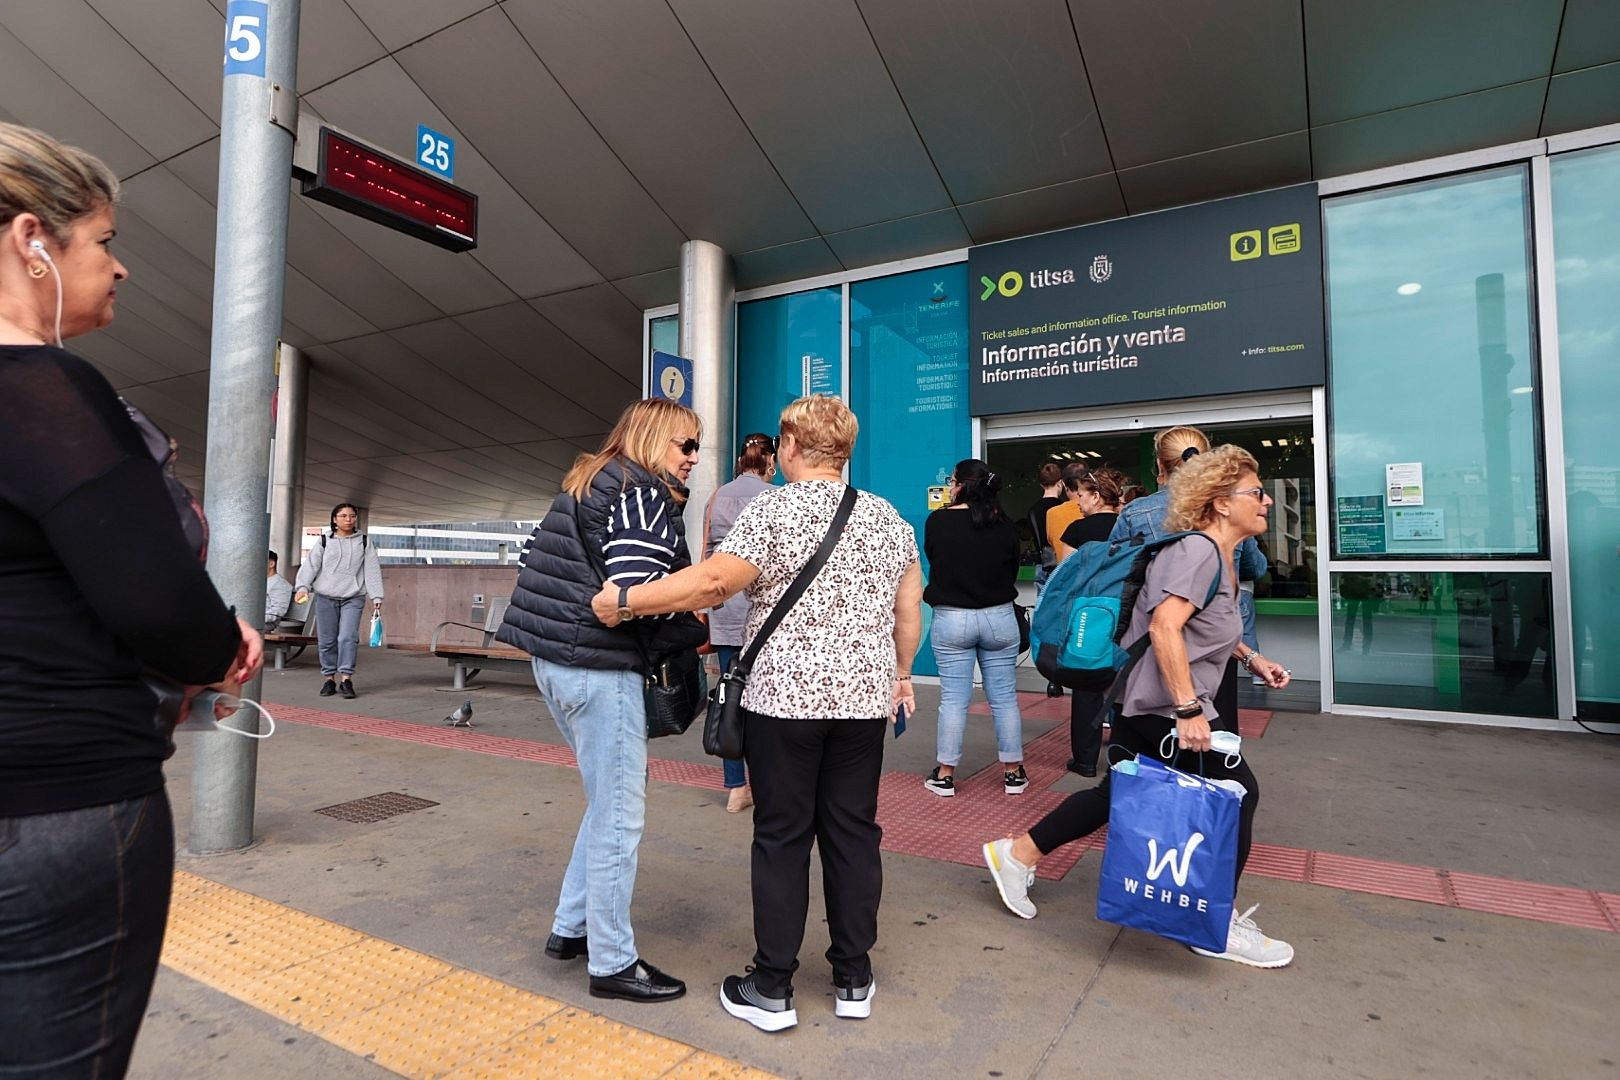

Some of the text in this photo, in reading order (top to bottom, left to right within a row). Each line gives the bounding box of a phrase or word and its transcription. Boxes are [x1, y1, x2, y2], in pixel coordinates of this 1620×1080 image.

[224, 15, 262, 64] 5
[421, 133, 449, 171] 25
[1030, 269, 1075, 288] titsa
[918, 301, 960, 312] TENERIFE
[981, 300, 1227, 341] Ticket sales and information office. Tourist information
[982, 324, 1186, 366] Información y venta
[1268, 343, 1305, 353] titsa.com
[982, 354, 1139, 383] Información turística
[1124, 877, 1208, 913] WEHBE
